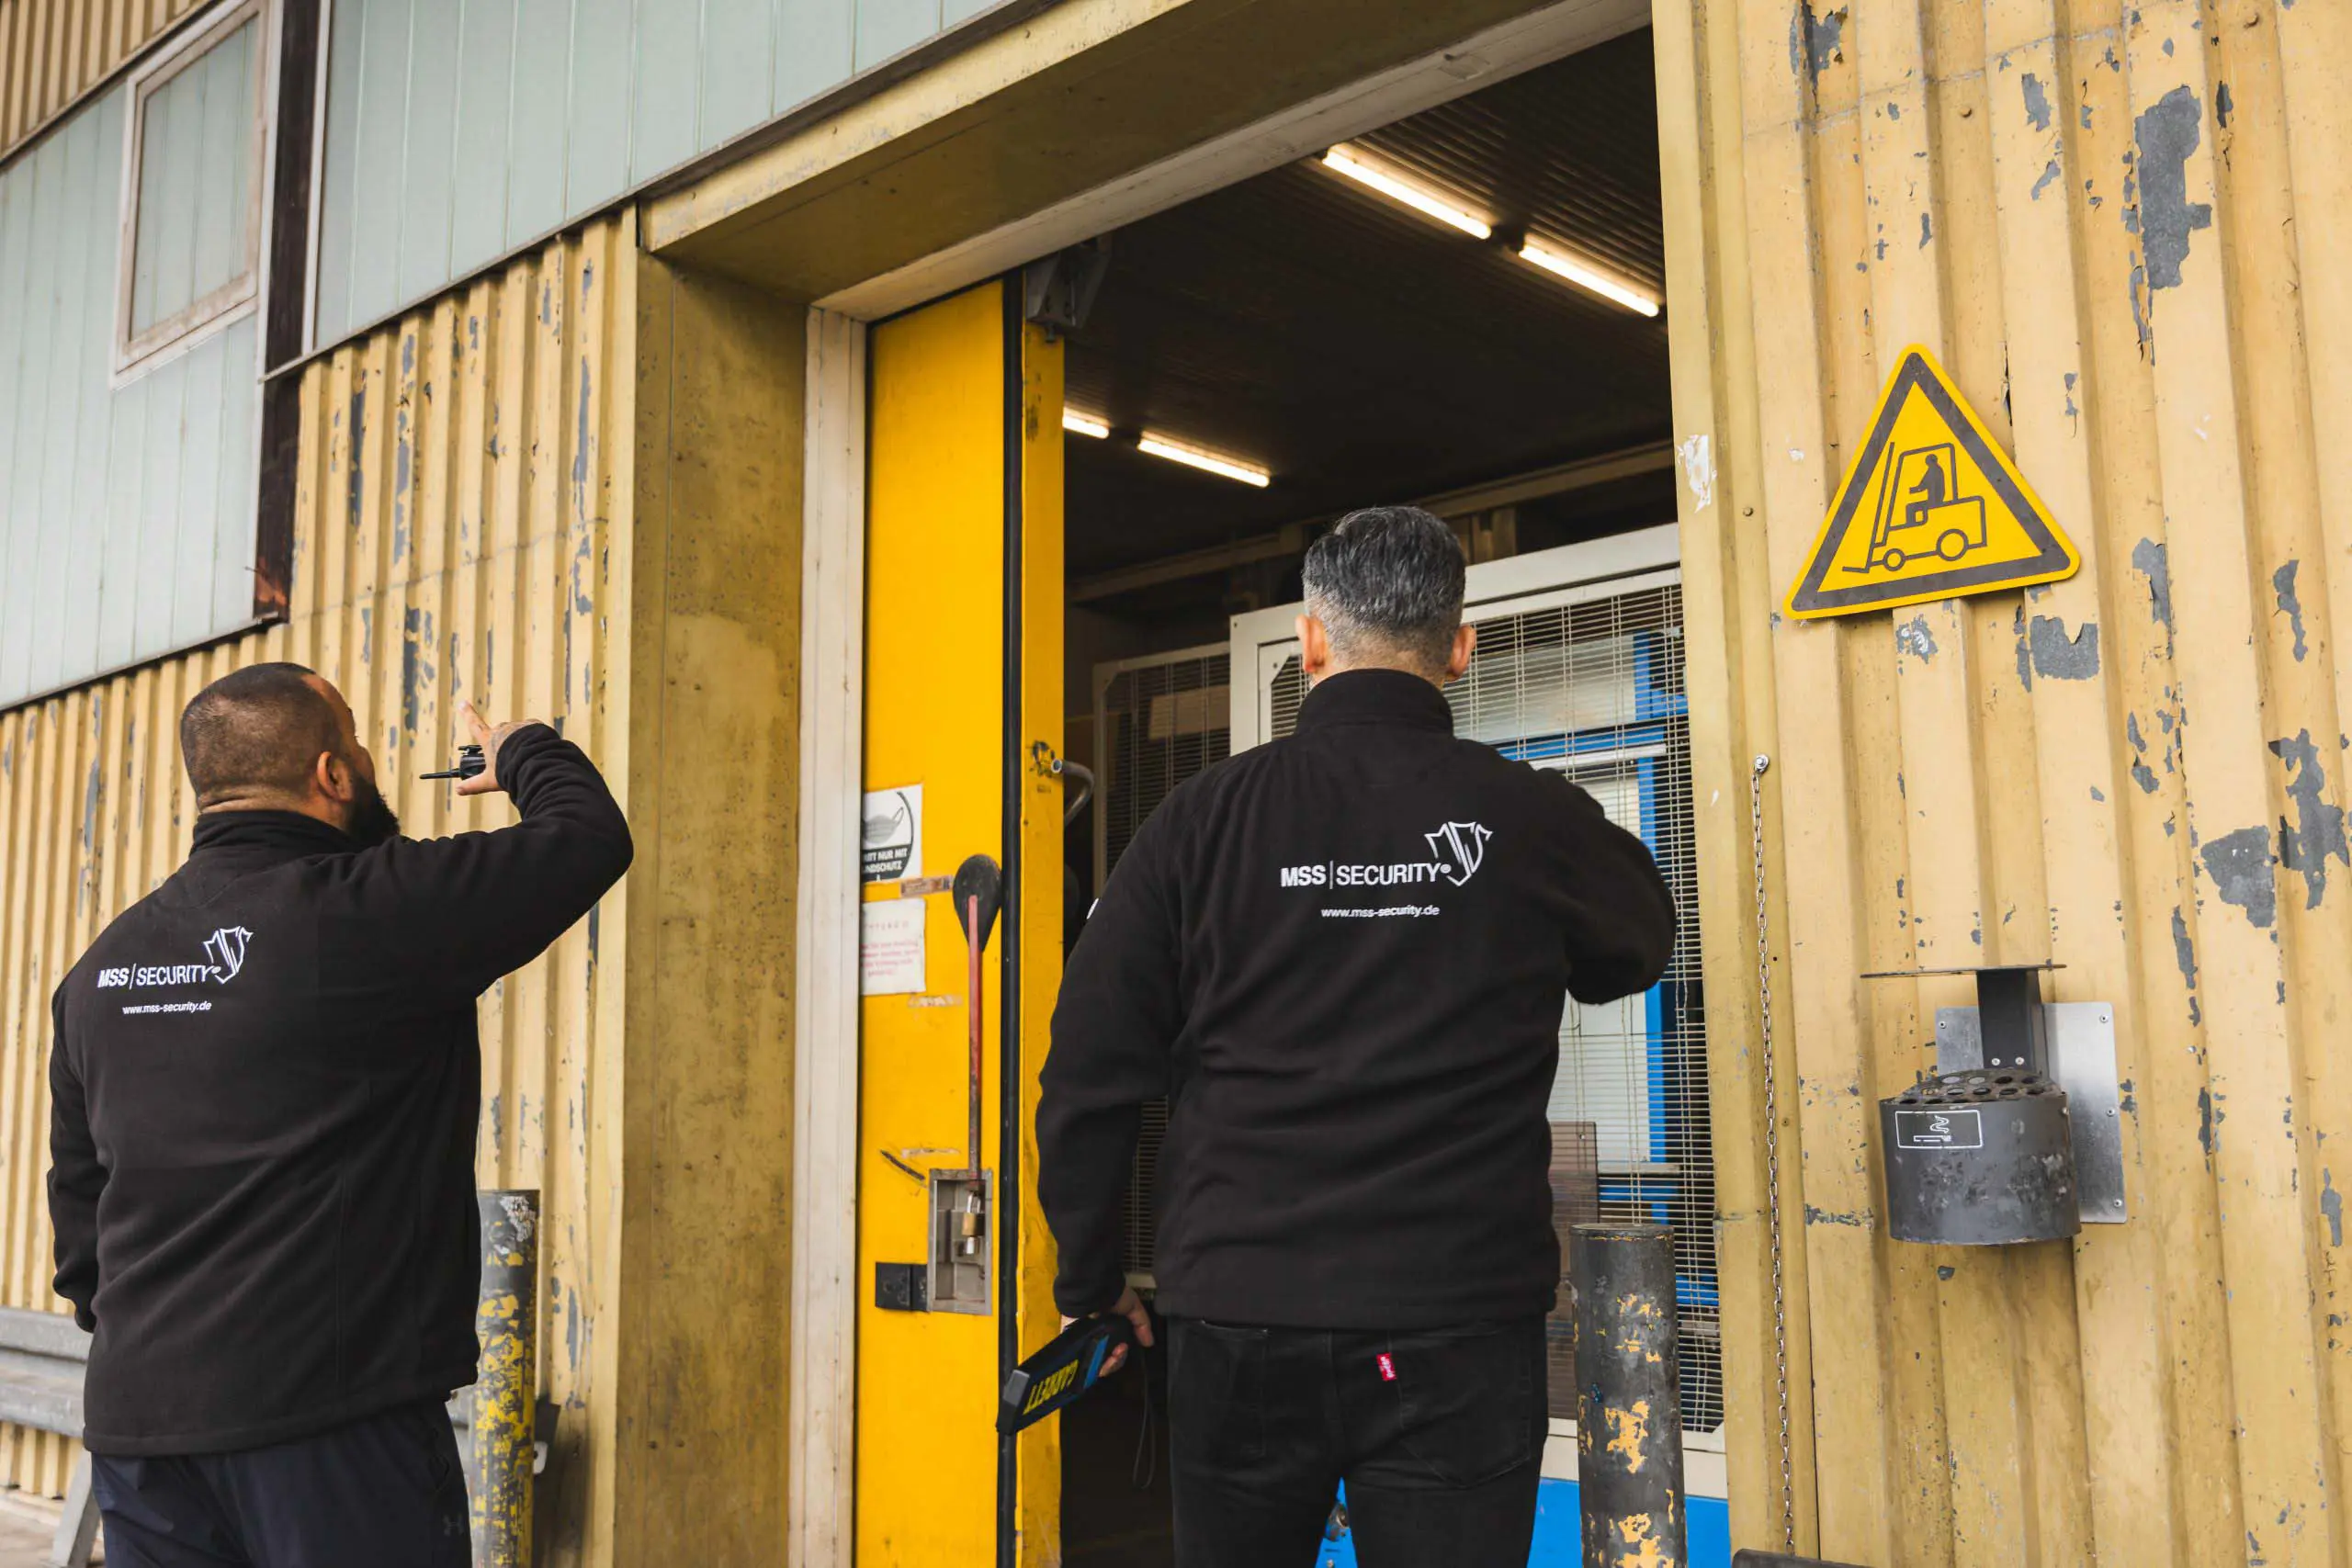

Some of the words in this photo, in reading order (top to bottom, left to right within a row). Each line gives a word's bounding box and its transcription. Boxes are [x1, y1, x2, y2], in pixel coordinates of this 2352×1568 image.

[1280, 864, 1327, 887] MSS
[1320, 904, 1441, 919] www.mss-security.de
[97, 967, 130, 988] MSS
[122, 1000, 212, 1014] www.mss-security.de
[1023, 1359, 1079, 1415] GARRETT
